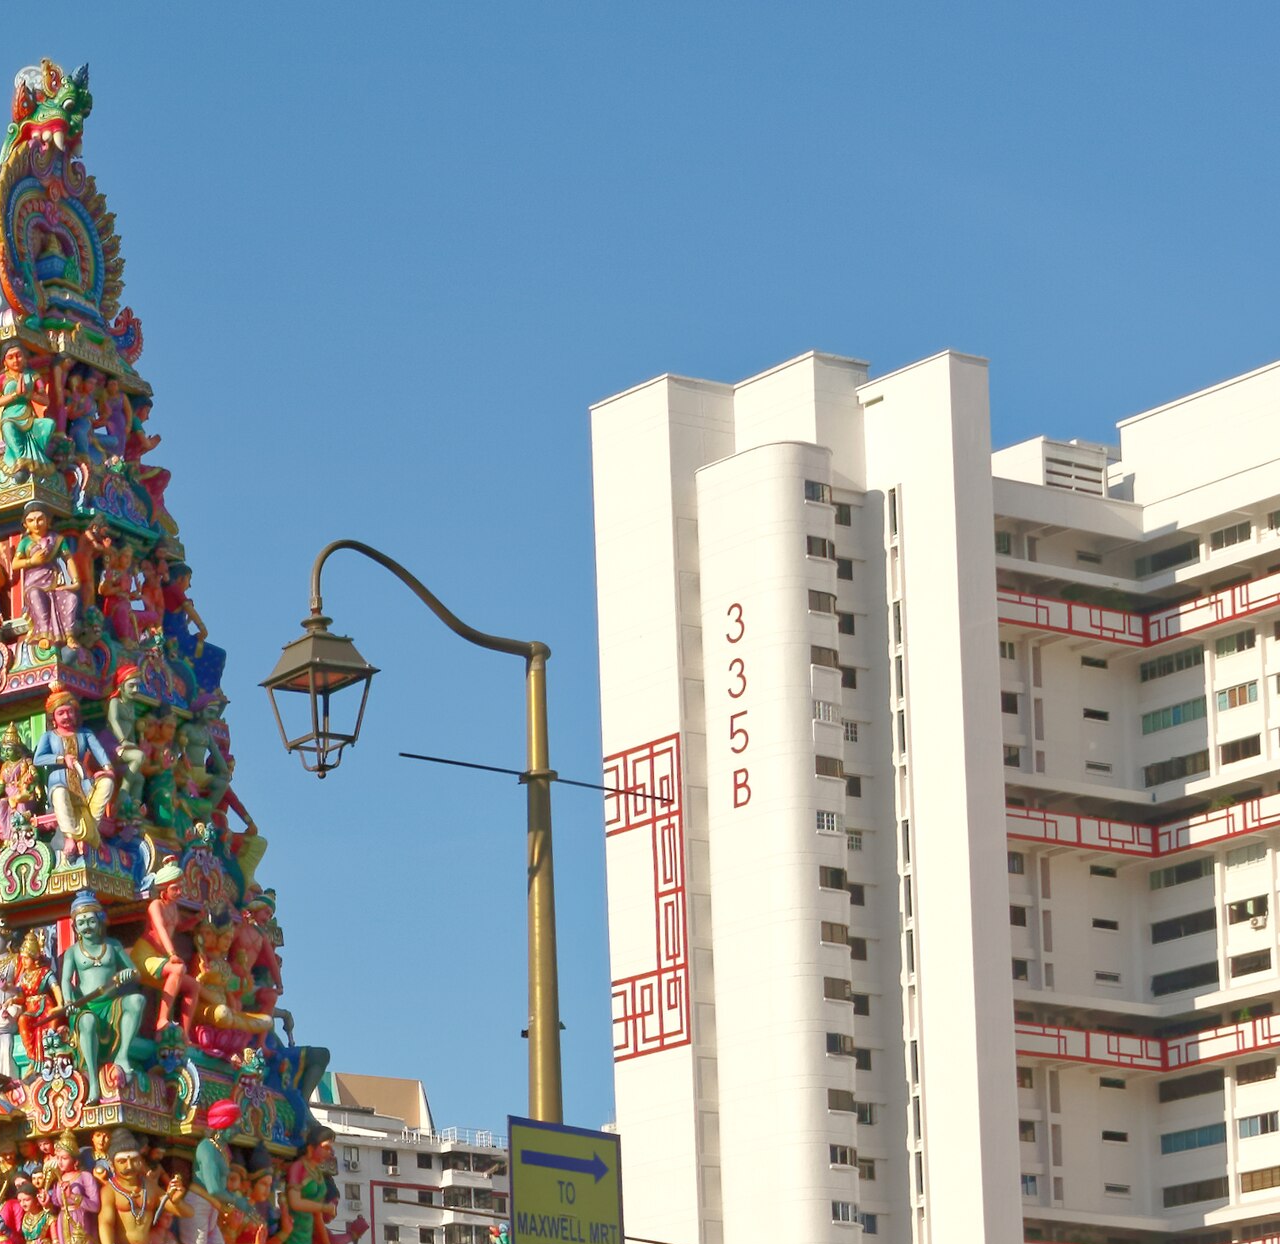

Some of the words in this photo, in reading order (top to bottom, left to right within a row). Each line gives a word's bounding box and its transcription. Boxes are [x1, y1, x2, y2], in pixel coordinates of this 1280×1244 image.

[726, 602, 751, 809] 335B
[557, 1180, 576, 1205] TO
[517, 1211, 586, 1243] MAXWELL
